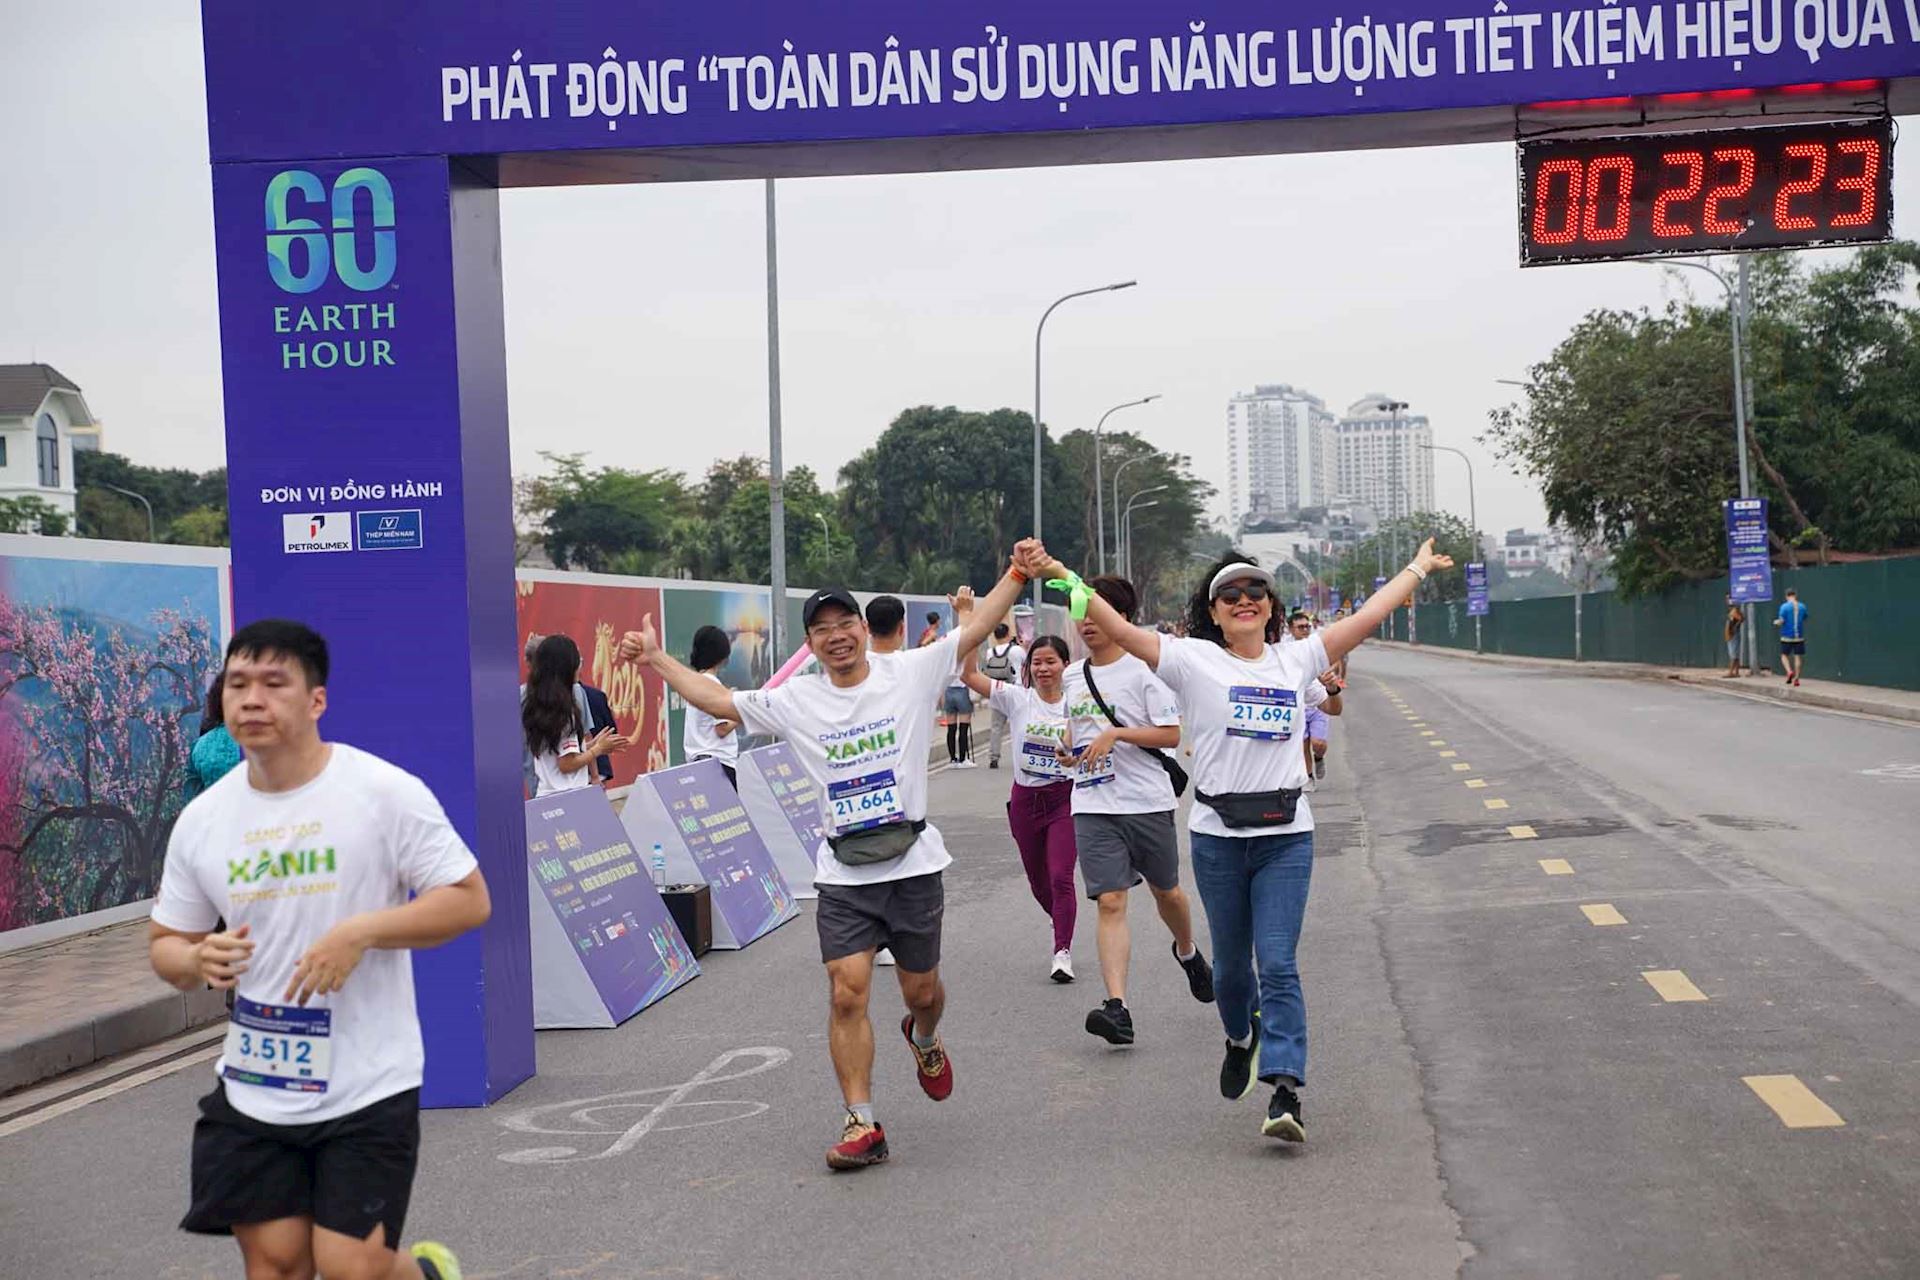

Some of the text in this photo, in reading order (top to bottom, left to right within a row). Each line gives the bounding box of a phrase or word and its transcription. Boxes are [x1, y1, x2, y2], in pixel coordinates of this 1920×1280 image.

[442, 49, 557, 121] PHÁT
[565, 46, 687, 131] ĐỘNG
[850, 35, 941, 107] DÂN
[952, 25, 1008, 103] SỬ
[1018, 38, 1139, 112] DỤNG
[1150, 20, 1277, 92] NĂNG
[1287, 15, 1437, 96] LƯỢNG
[1533, 139, 1880, 244] 00 22 23
[264, 167, 398, 294] 60
[274, 302, 396, 334] EARTH
[282, 339, 396, 369] HOUR
[261, 478, 443, 505] ĐƠN VỊ ĐỒNG HÀNH
[288, 541, 349, 551] PETROLIMEX
[1233, 704, 1292, 722] 21.694
[825, 729, 896, 760] XANH
[836, 790, 893, 815] 21.664
[240, 1033, 312, 1064] 3.512
